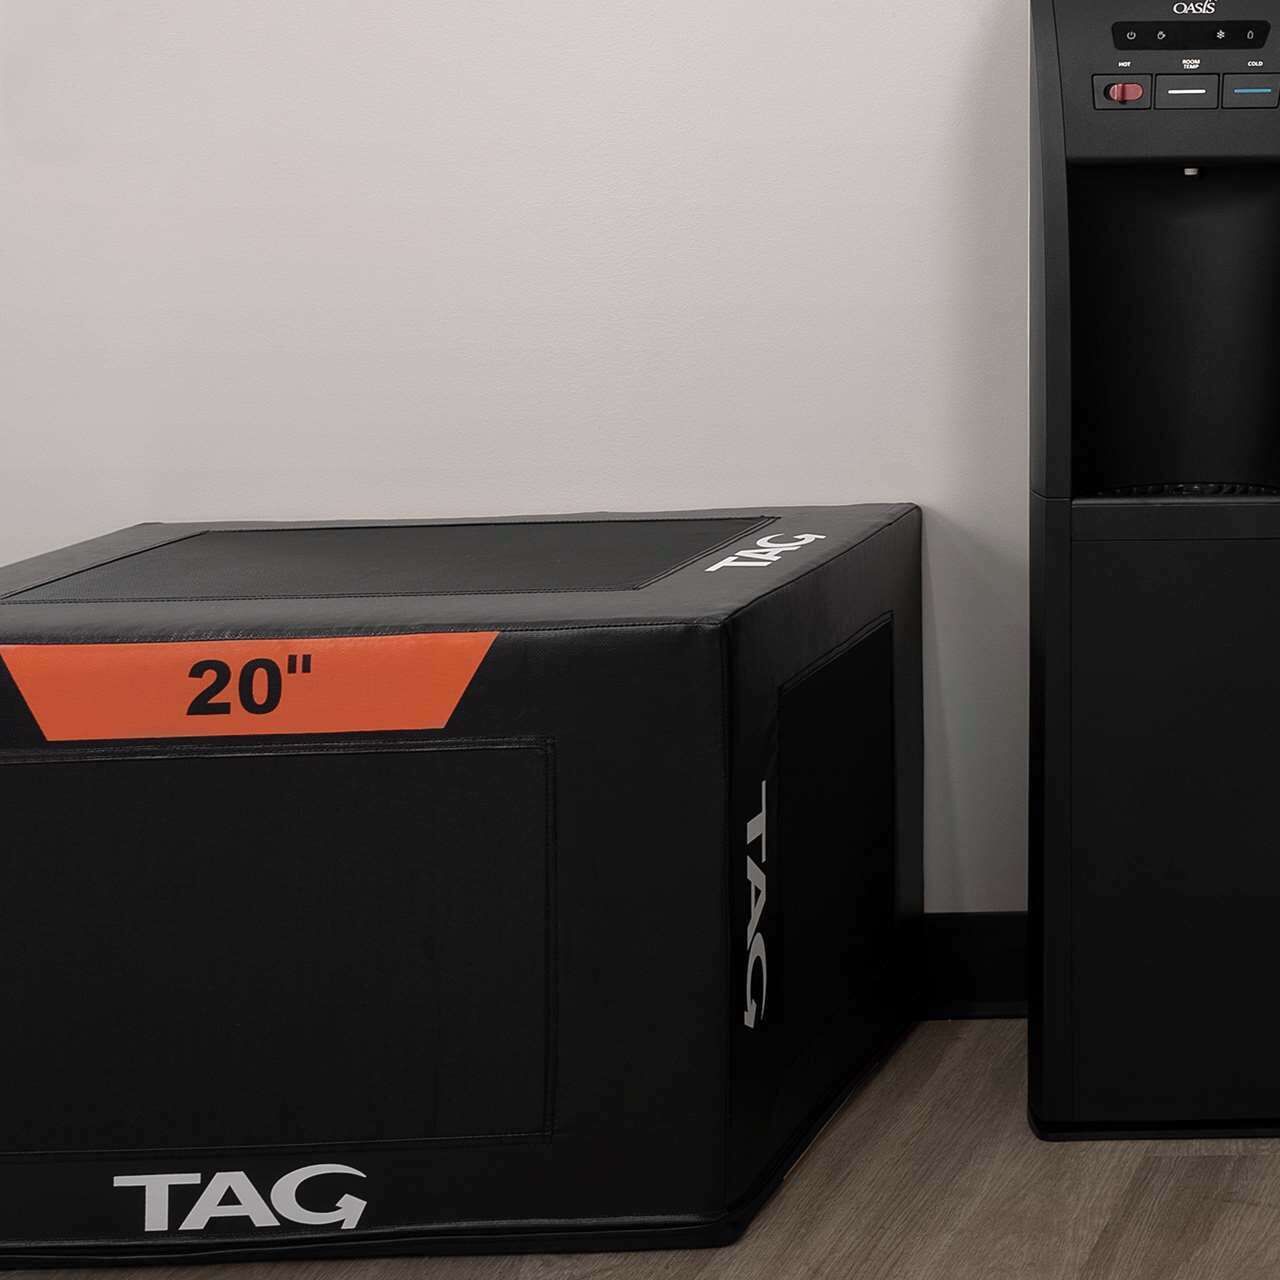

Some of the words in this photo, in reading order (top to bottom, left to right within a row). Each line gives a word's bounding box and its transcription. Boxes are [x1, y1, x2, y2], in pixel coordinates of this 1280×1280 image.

[705, 533, 826, 572] TAG
[186, 654, 312, 716] 20"
[745, 781, 769, 1029] TAG
[113, 1163, 368, 1231] TAG
